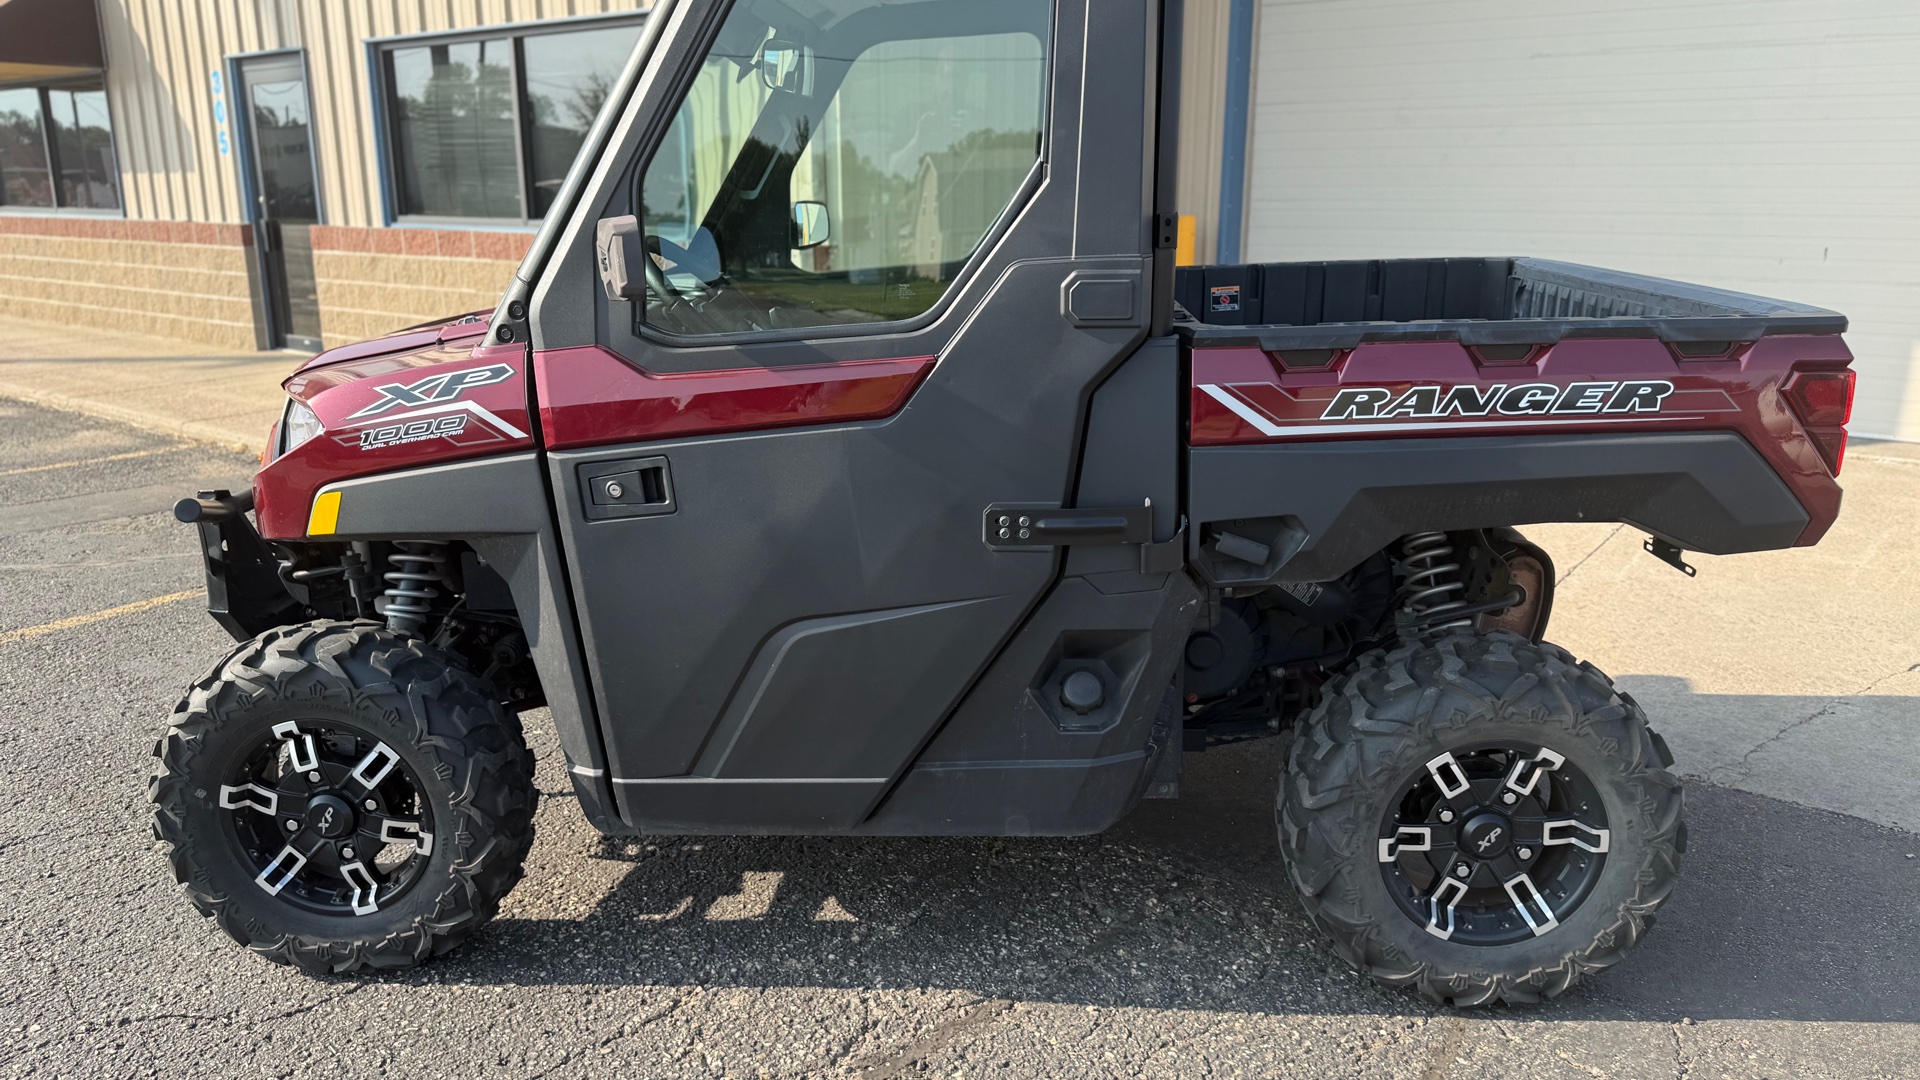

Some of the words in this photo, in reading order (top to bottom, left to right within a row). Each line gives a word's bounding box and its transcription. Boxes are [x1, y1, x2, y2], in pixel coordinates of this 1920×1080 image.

[340, 362, 517, 421] XP
[1319, 379, 1675, 421] RANGER
[359, 413, 468, 447] 1000
[361, 442, 386, 451] DUAL
[388, 433, 440, 446] OVERHEAD
[442, 429, 464, 438] CAM
[317, 806, 334, 835] XP
[1477, 827, 1502, 853] XP
